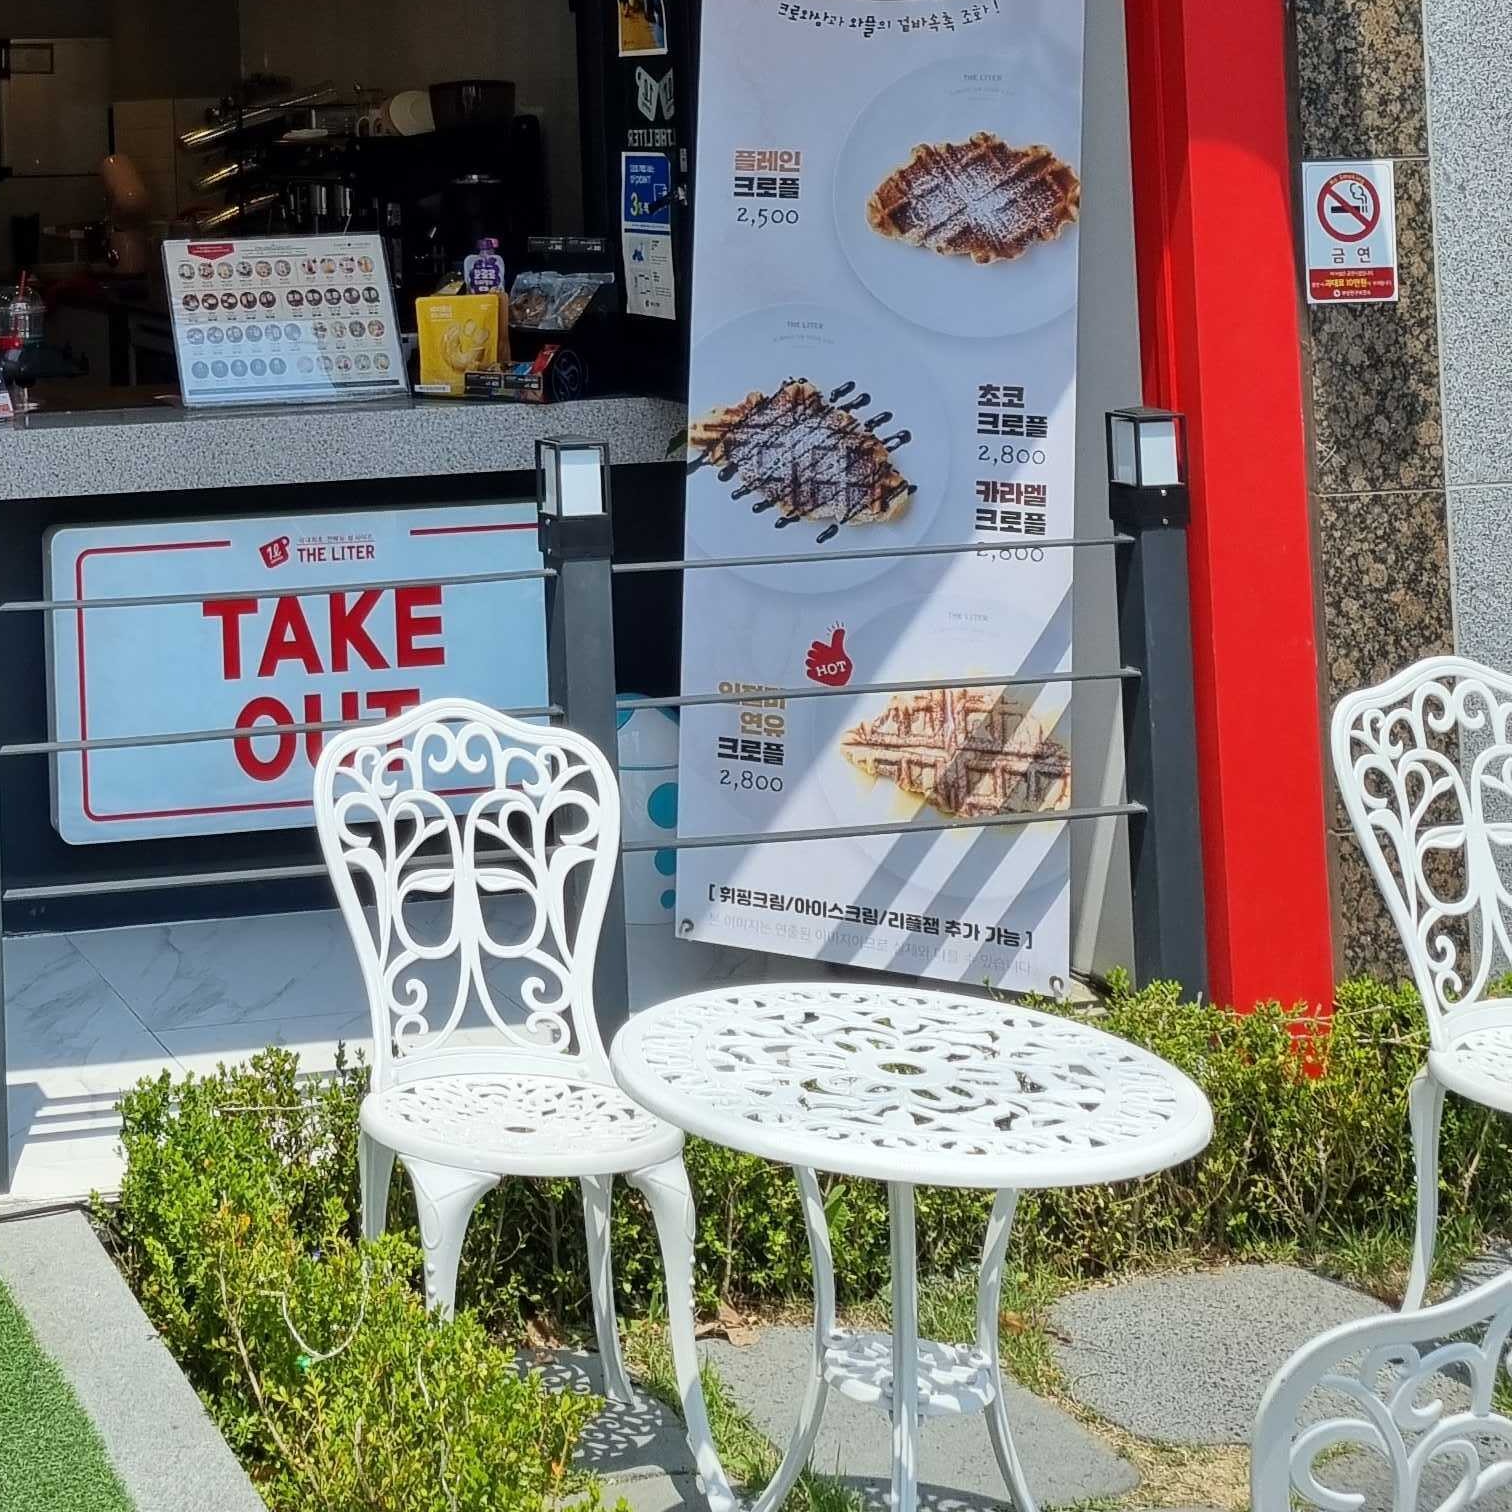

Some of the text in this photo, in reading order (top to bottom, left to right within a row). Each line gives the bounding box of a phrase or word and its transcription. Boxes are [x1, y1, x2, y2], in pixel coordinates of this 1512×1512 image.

[777, 0, 845, 29] 크로와상과
[734, 149, 801, 174] 플레인
[733, 176, 800, 200] 크로플
[736, 206, 800, 231] 2,500
[977, 384, 1025, 409] 초코
[976, 412, 1048, 439] 크로플
[977, 444, 1046, 468] 2,800
[975, 480, 1047, 507] 카라멜
[974, 508, 1047, 536] 크로플
[297, 544, 376, 563] THE LITER
[202, 584, 446, 681] TAKE
[816, 660, 846, 678] HOT
[717, 736, 785, 766] 크로플
[720, 769, 784, 792] 2,800
[944, 918, 981, 942] 추가
[984, 924, 1021, 947] 가능
